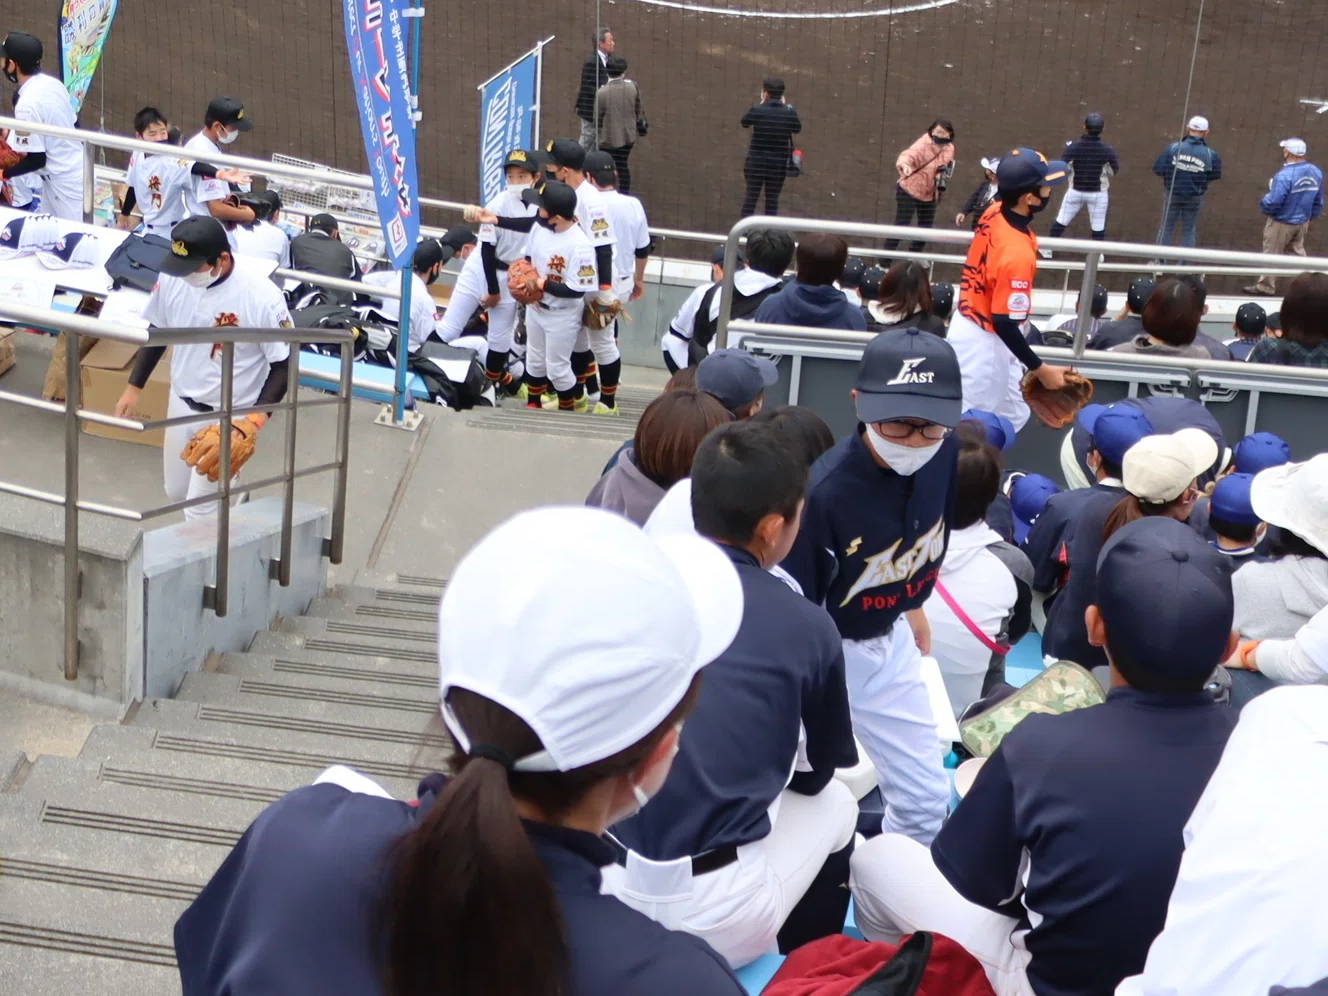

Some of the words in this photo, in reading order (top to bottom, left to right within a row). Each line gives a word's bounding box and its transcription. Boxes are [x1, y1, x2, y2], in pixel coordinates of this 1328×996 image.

[1011, 280, 1029, 289] ECC
[885, 356, 935, 386] EAST
[862, 592, 902, 611] PON
